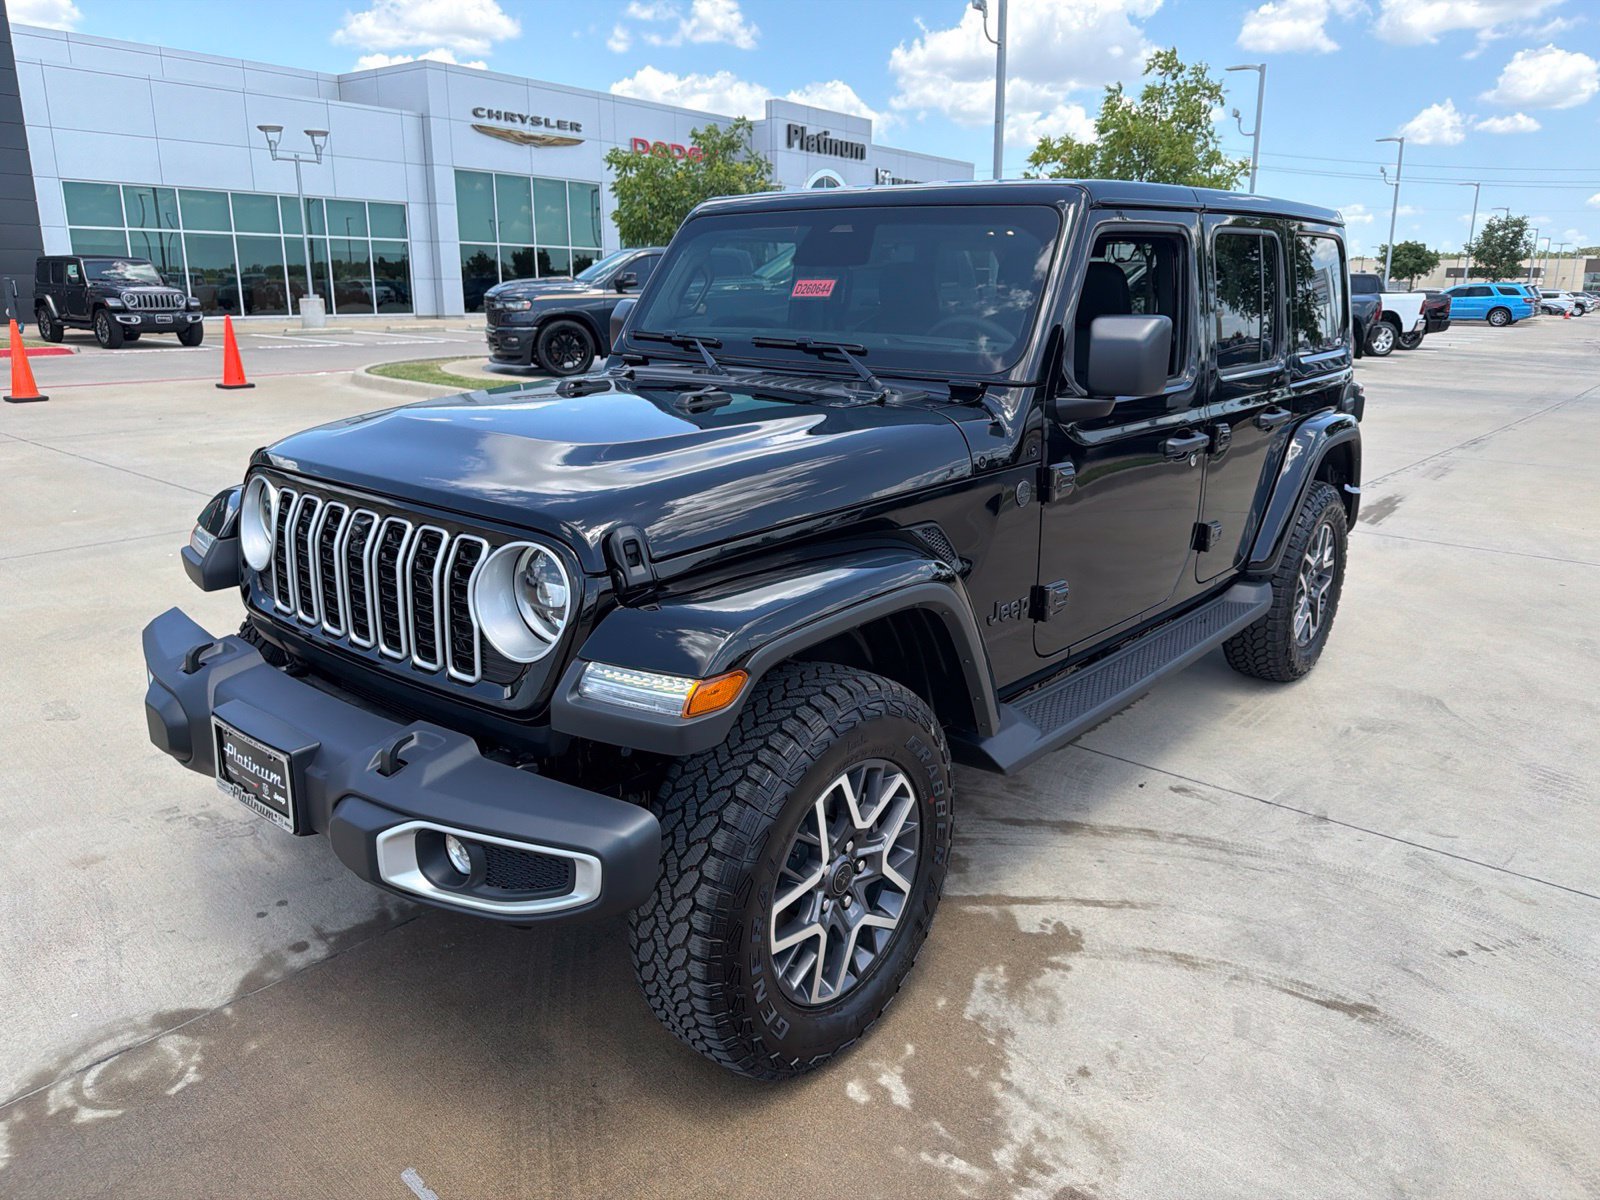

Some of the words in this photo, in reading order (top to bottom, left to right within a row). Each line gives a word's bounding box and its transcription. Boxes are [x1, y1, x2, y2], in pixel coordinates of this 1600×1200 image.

[471, 106, 584, 133] CHRYSLER
[631, 137, 719, 162] DODG
[786, 123, 867, 161] Platinum
[794, 283, 833, 295] D260644
[986, 596, 1029, 627] Jeep
[223, 742, 285, 789] Platinum
[232, 783, 278, 821] Platinum
[903, 735, 947, 866] GRABBER
